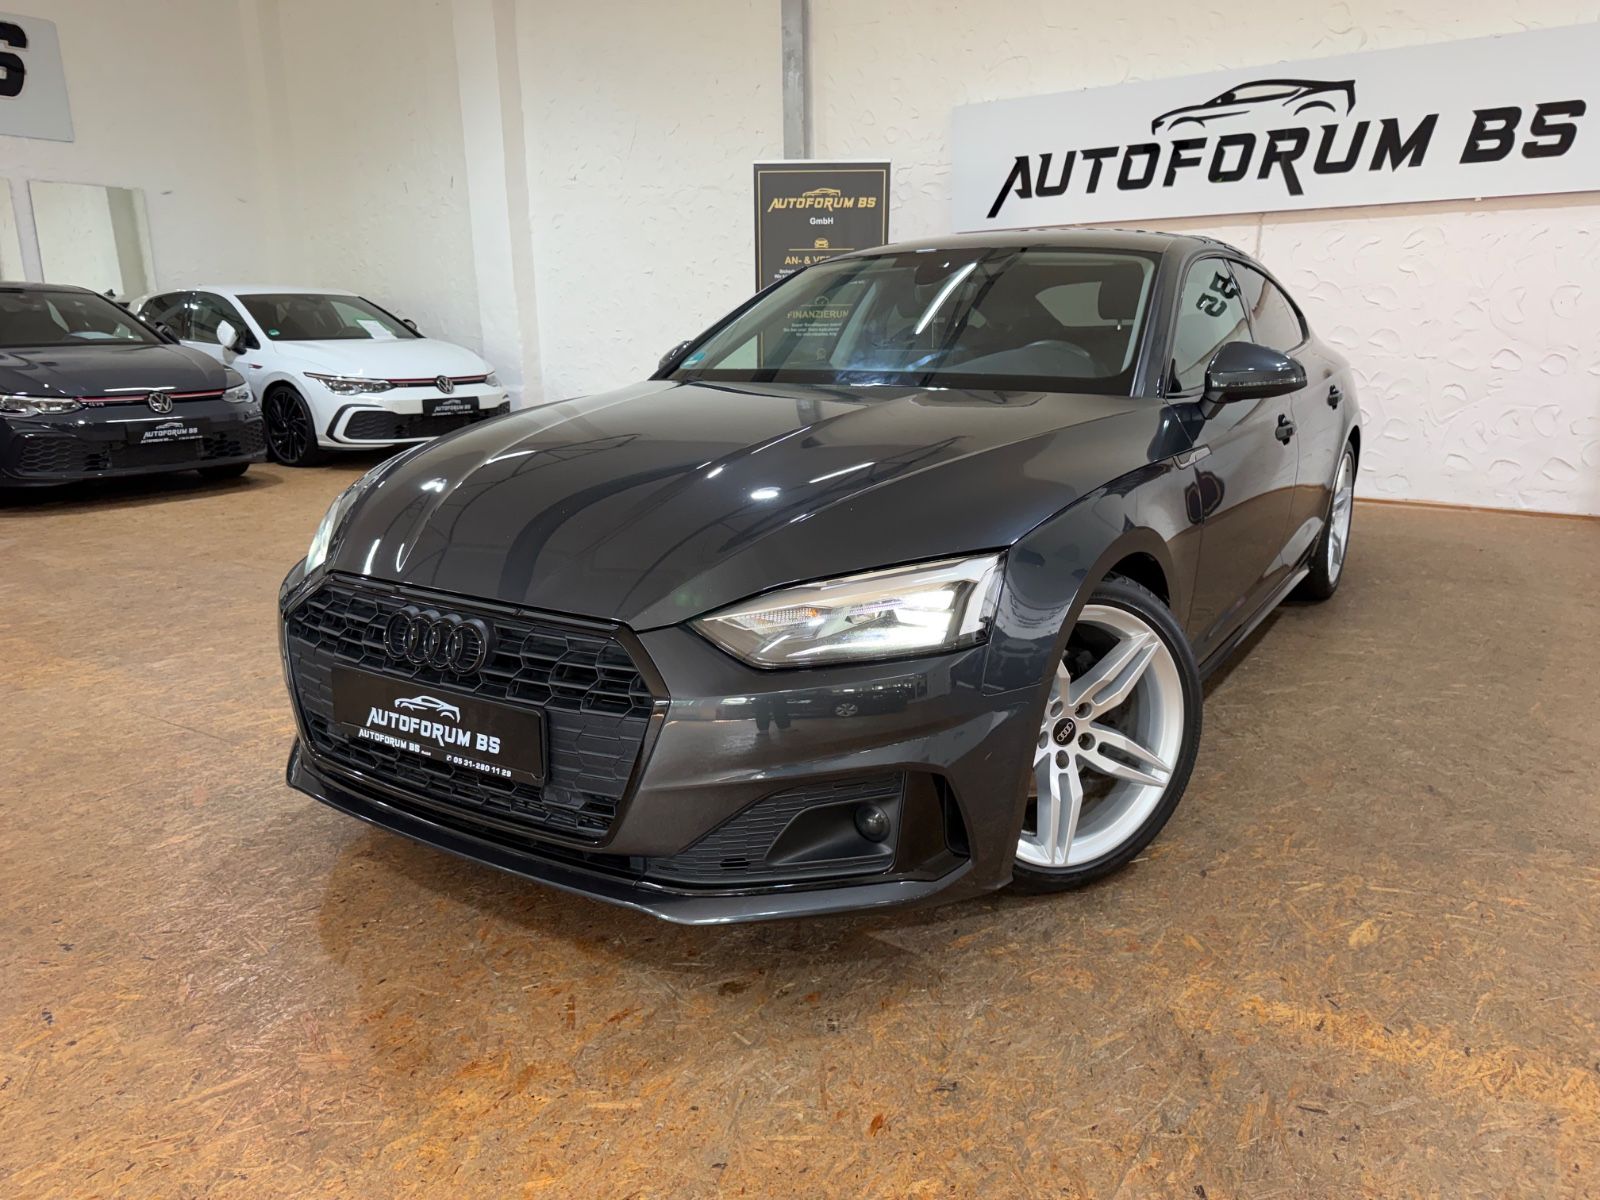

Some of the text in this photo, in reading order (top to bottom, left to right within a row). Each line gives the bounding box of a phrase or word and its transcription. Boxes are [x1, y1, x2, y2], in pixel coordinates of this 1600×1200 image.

[986, 99, 1587, 218] AUTOFORUM BS
[767, 196, 877, 213] AUTOFORUM BS
[809, 217, 834, 225] GmbH
[785, 256, 802, 265] AN-
[804, 256, 811, 265] &
[143, 428, 188, 440] AUTOFORUM
[366, 706, 501, 754] AUTOFORUM BS
[358, 728, 420, 753] AUTOFORUM BS
